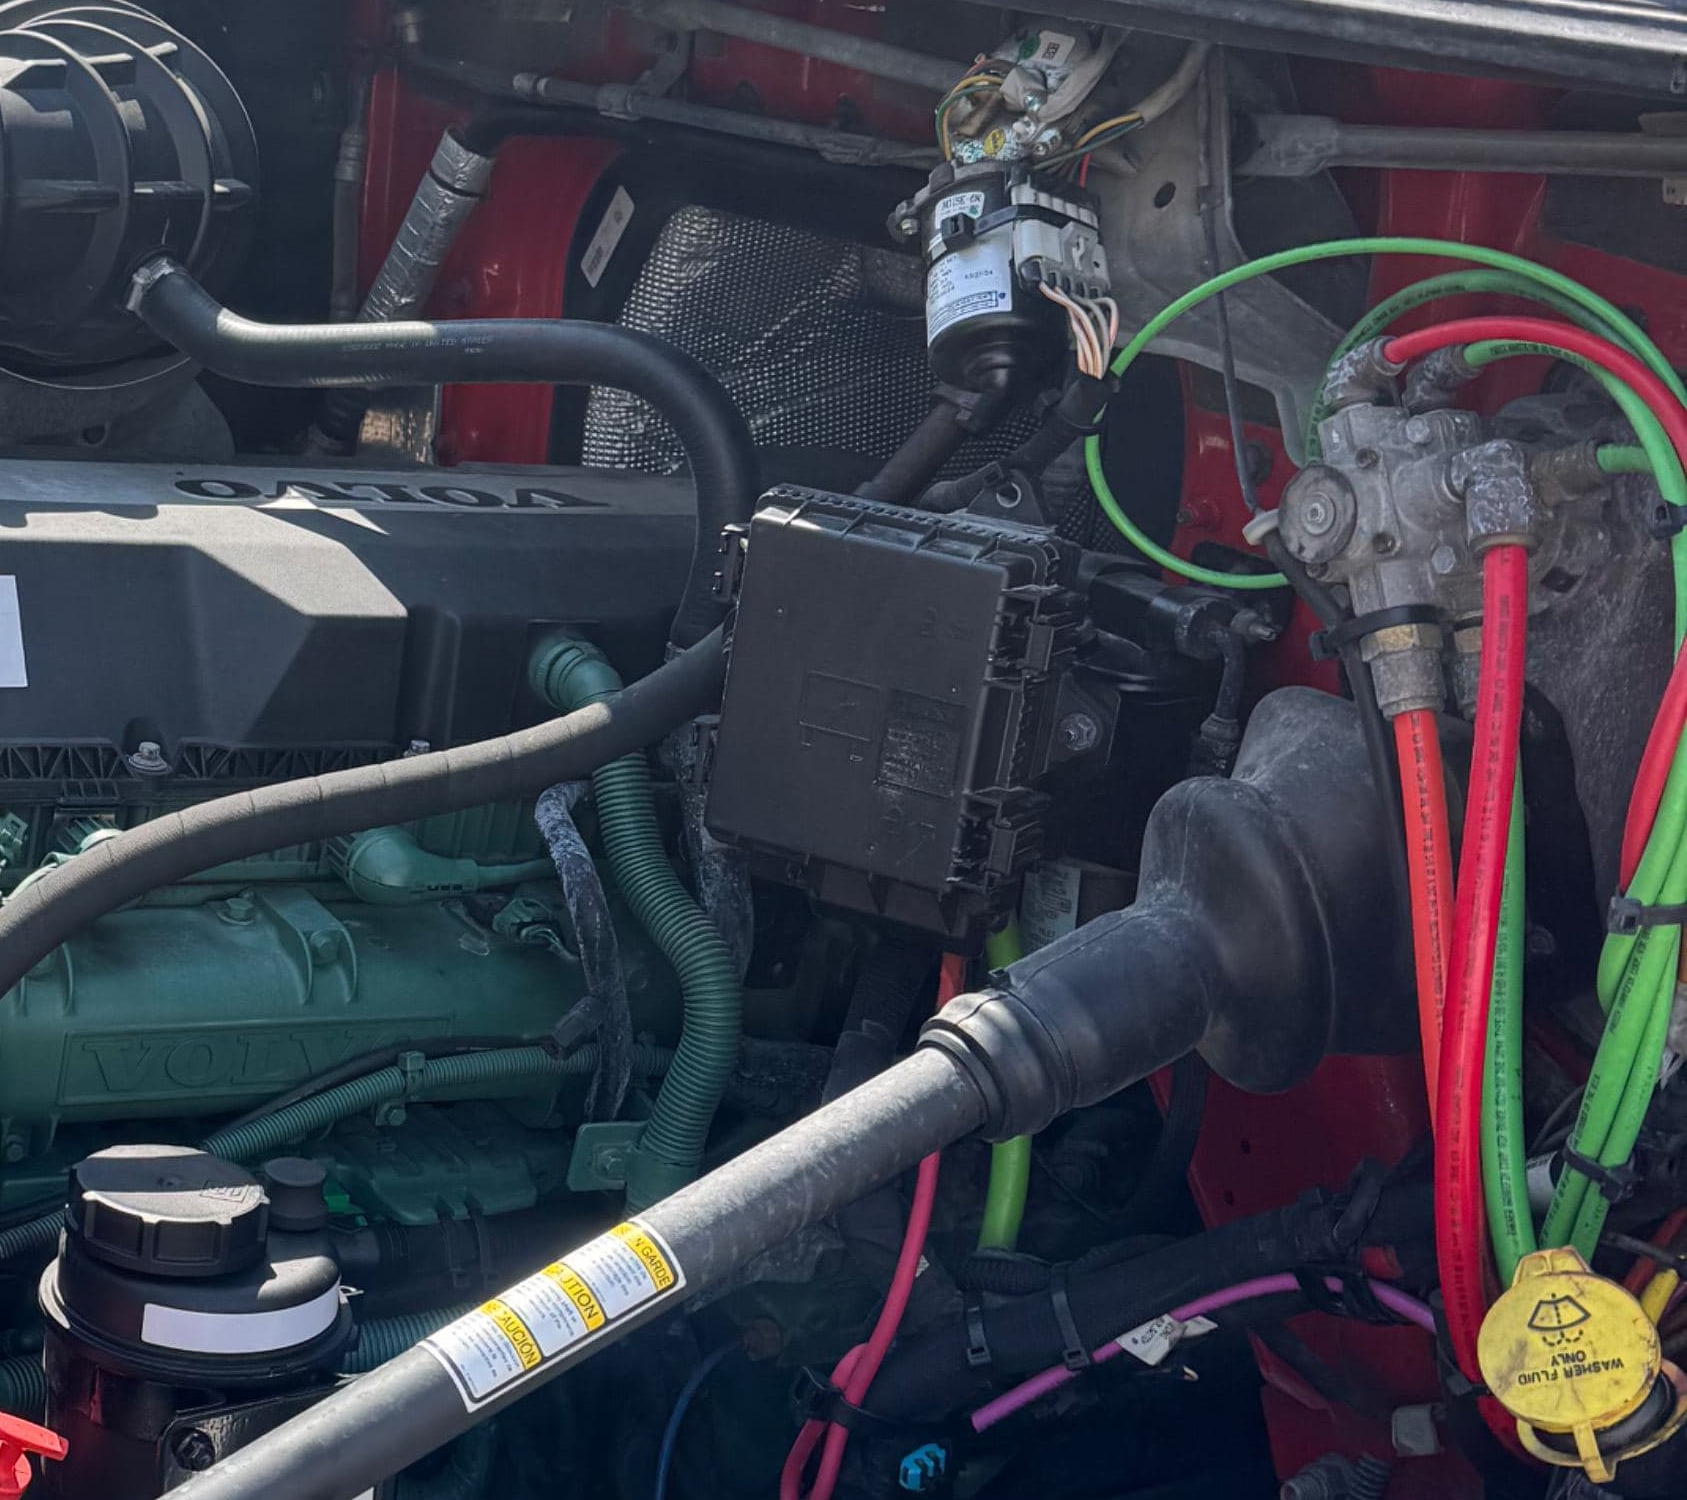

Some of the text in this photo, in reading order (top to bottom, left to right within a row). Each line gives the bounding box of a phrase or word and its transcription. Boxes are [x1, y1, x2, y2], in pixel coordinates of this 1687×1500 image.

[174, 479, 610, 508] VOLVO
[641, 1245, 671, 1287] GARDE
[1518, 1357, 1624, 1385] WASHER FLUID
[1551, 1350, 1586, 1367] ONLY
